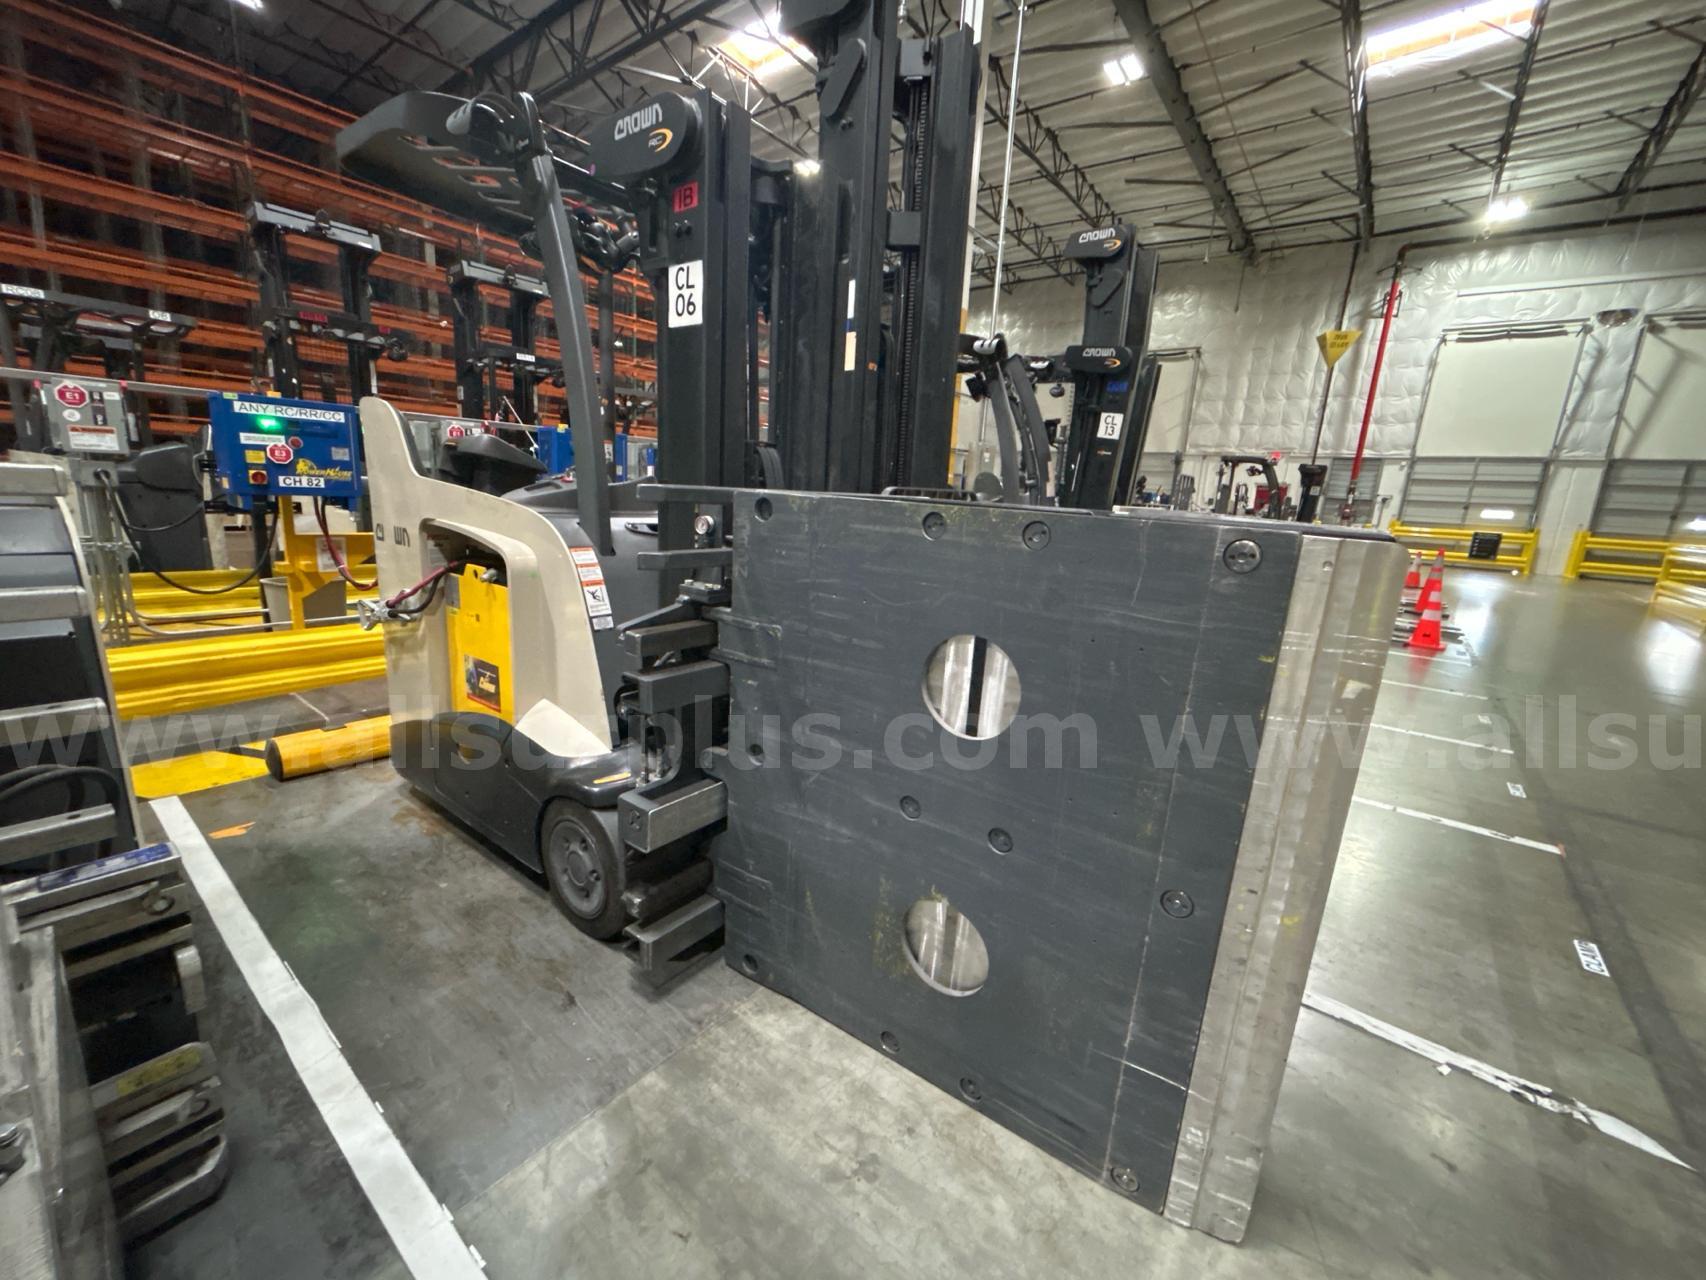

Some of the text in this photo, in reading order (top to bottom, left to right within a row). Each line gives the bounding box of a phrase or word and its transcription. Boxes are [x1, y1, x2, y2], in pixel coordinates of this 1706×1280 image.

[614, 103, 663, 140] CROWN
[1079, 227, 1116, 243] CROWN
[675, 267, 695, 290] CL
[675, 293, 697, 317] 06
[1082, 347, 1116, 357] CROWN
[238, 402, 342, 421] ANY RC/RR/CC
[1104, 415, 1117, 425] CL
[1104, 426, 1115, 436] 13
[283, 477, 321, 486] CH 82
[376, 523, 410, 547] CWN
